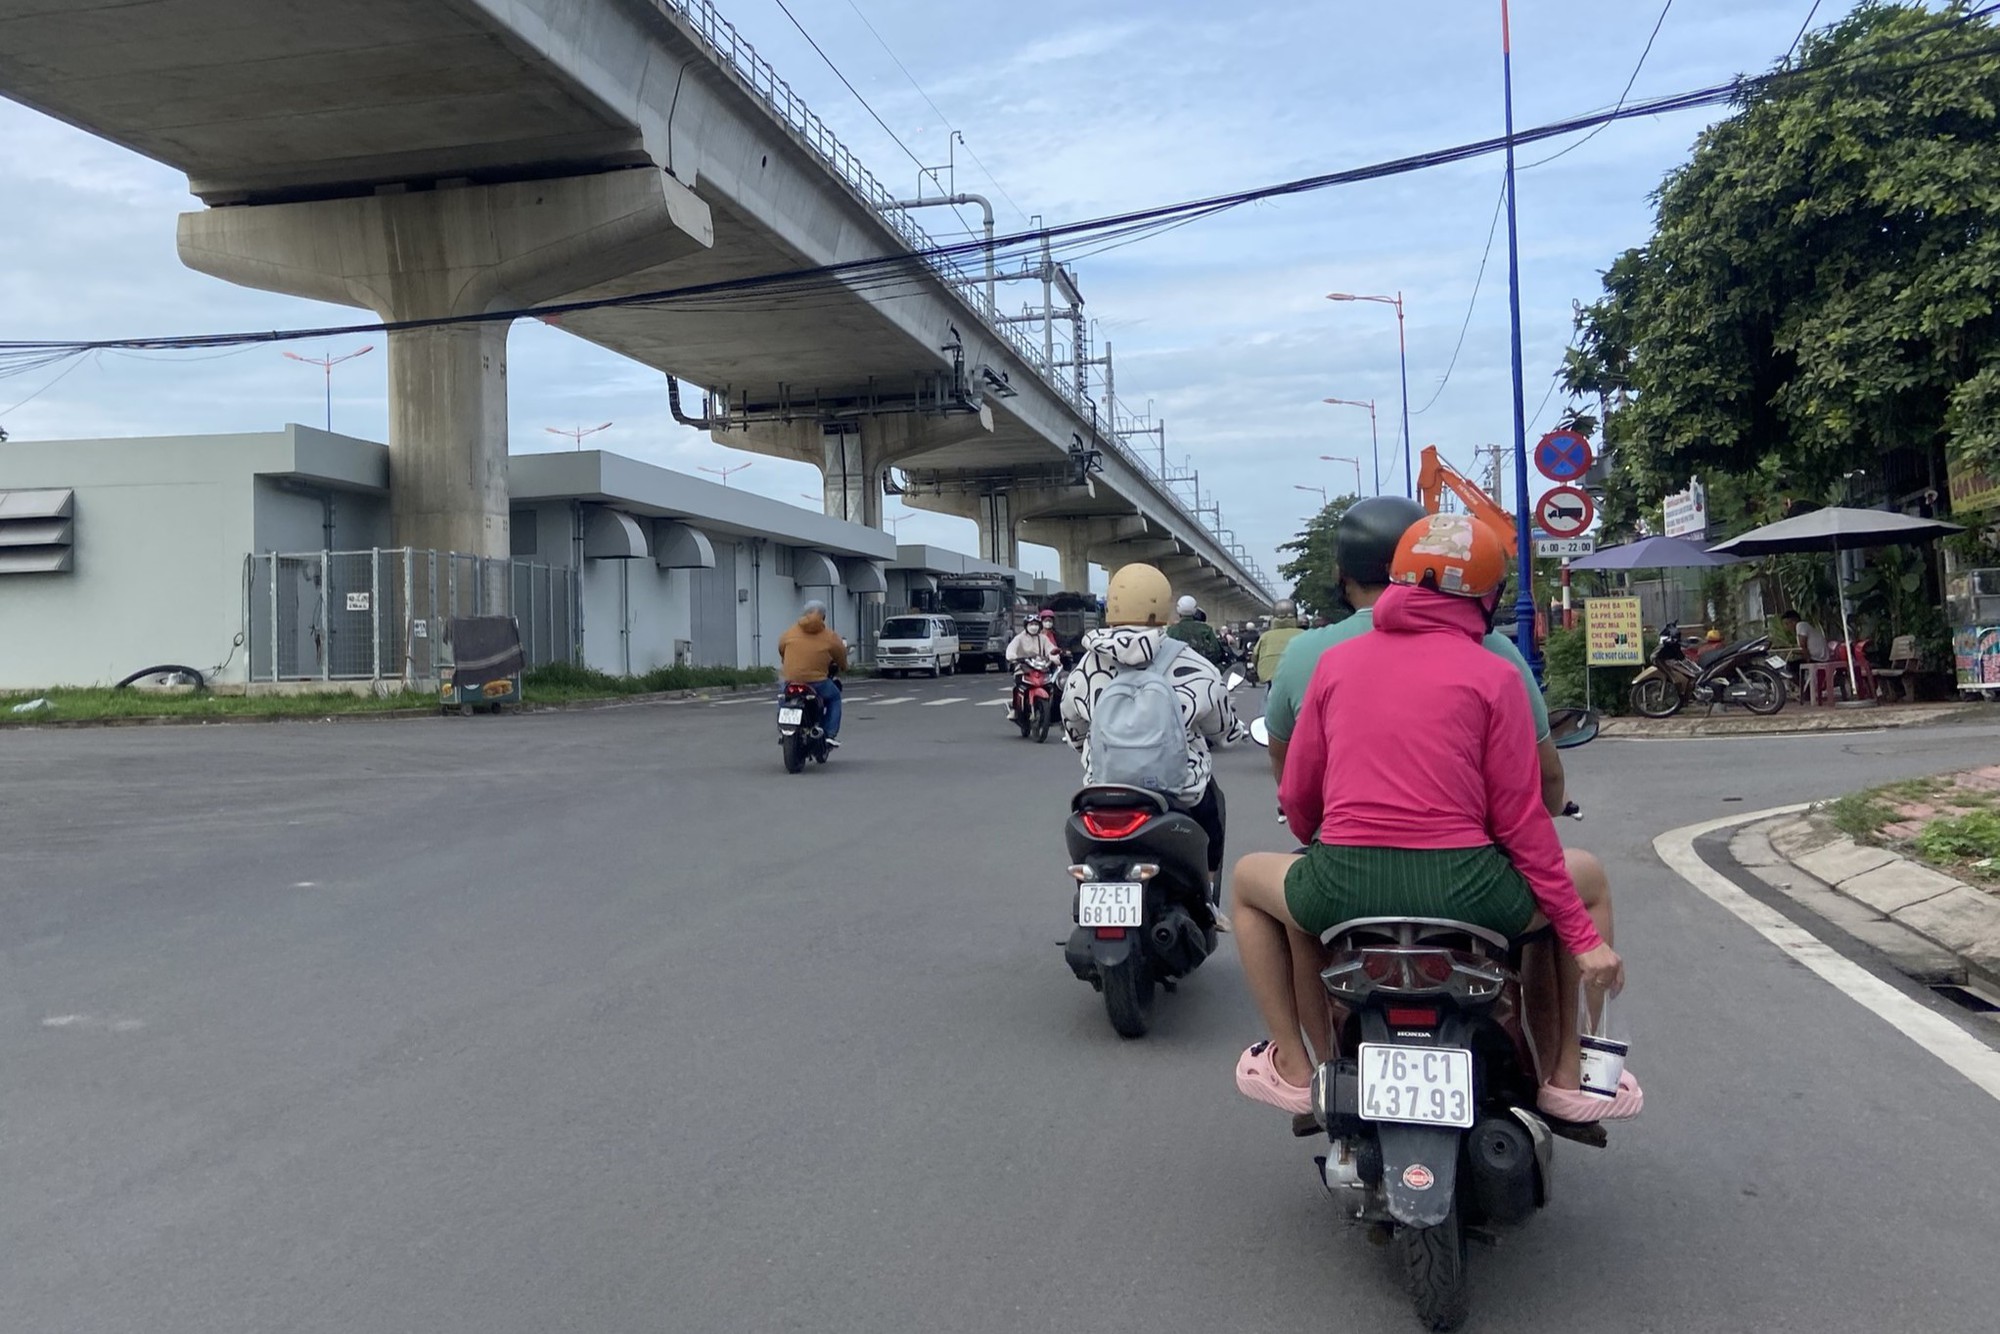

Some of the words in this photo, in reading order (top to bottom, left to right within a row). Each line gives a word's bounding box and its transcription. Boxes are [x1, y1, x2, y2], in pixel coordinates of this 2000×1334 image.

[1090, 886, 1130, 905] 72-E1
[1083, 905, 1136, 924] 681.01
[1397, 1030, 1432, 1038] HONDA
[1377, 1049, 1452, 1085] 76-C1
[1366, 1083, 1466, 1121] 437.93
